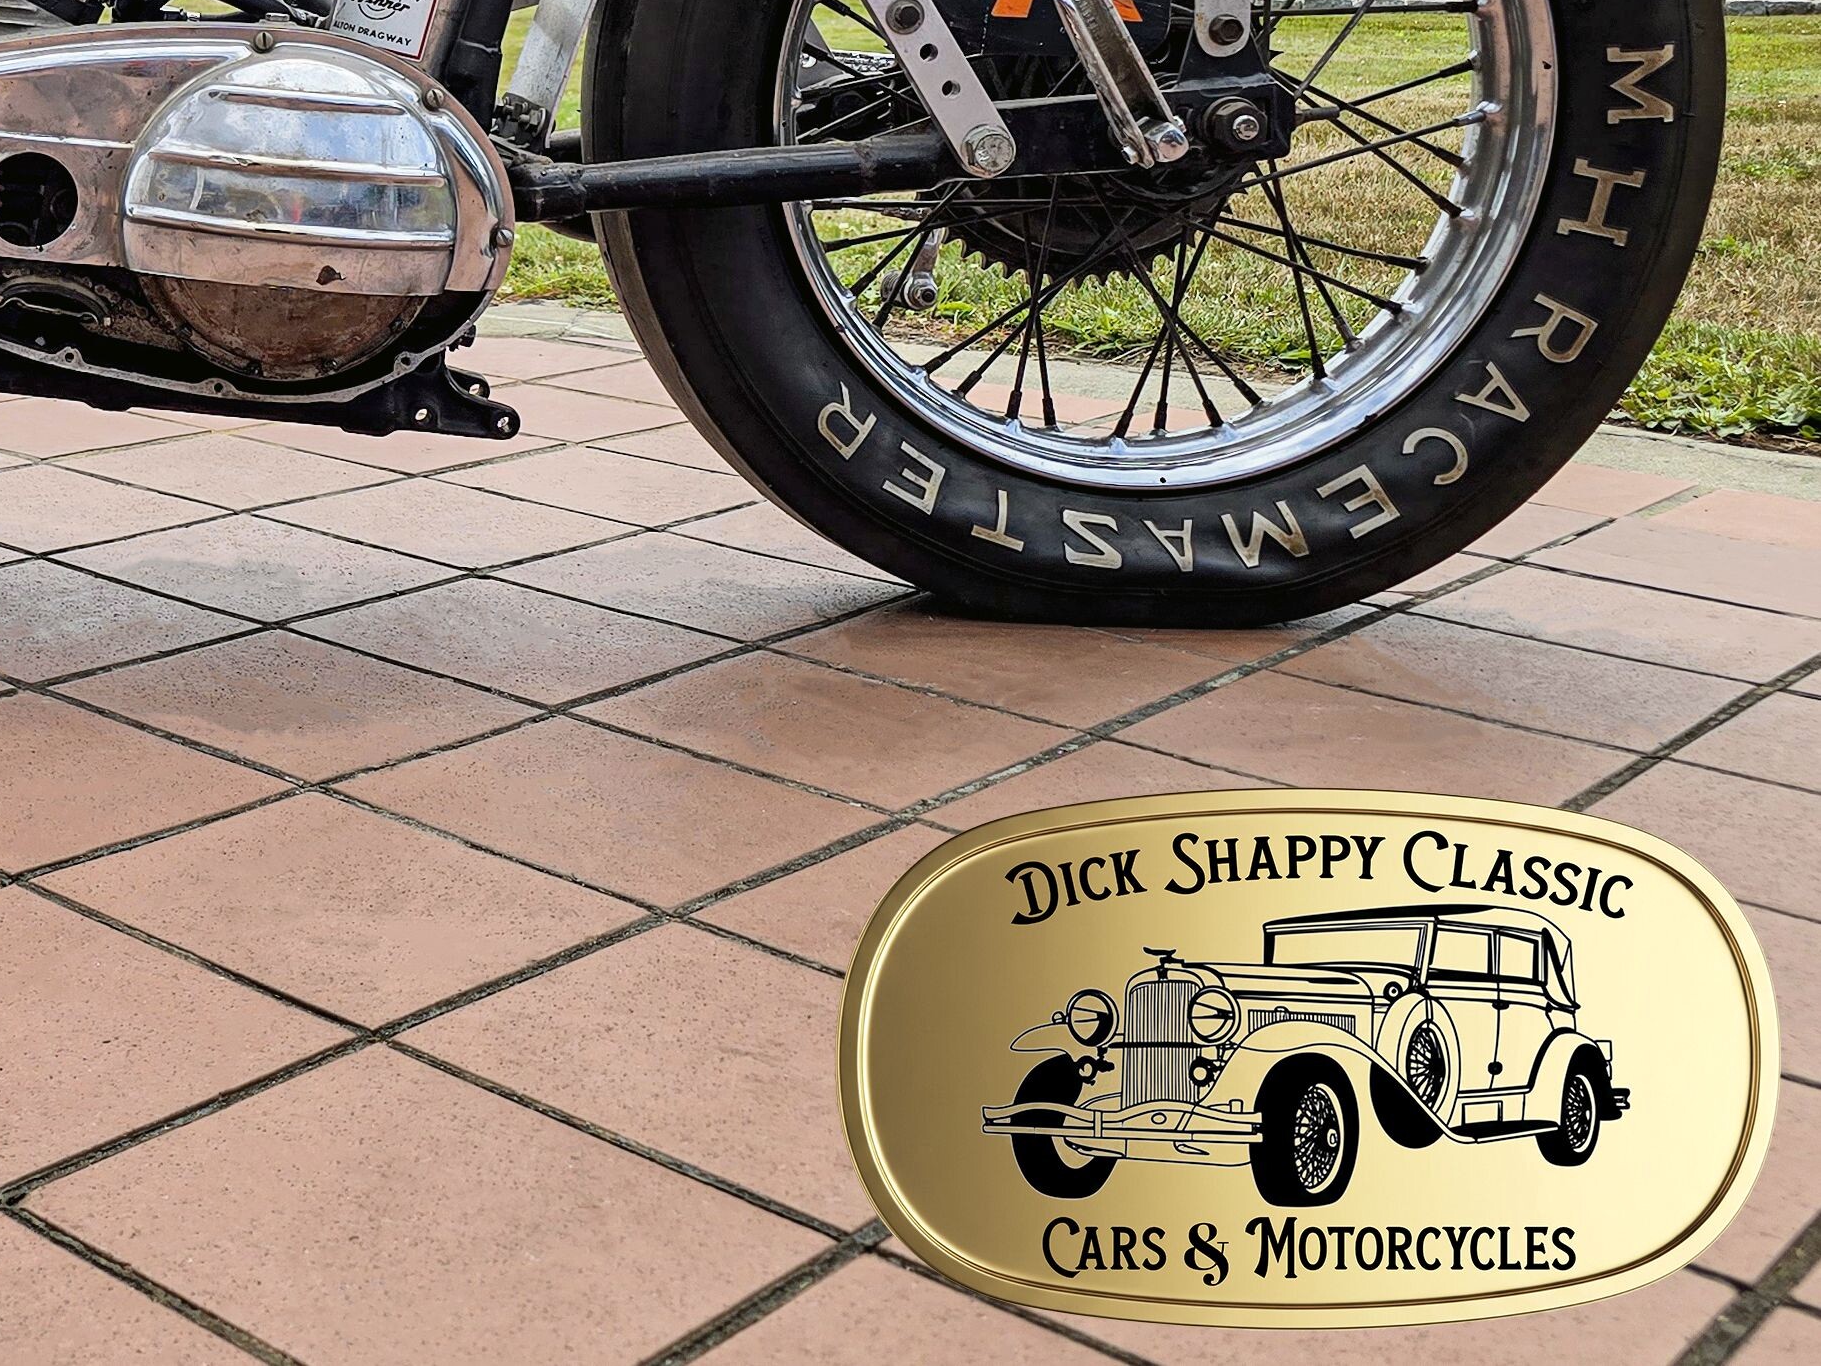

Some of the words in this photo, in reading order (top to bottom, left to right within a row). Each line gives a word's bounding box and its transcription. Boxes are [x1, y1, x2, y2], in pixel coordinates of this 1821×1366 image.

[333, 20, 356, 32] ALTON
[358, 26, 412, 46] DRAGWAY
[814, 290, 1599, 573] RACEMASTER
